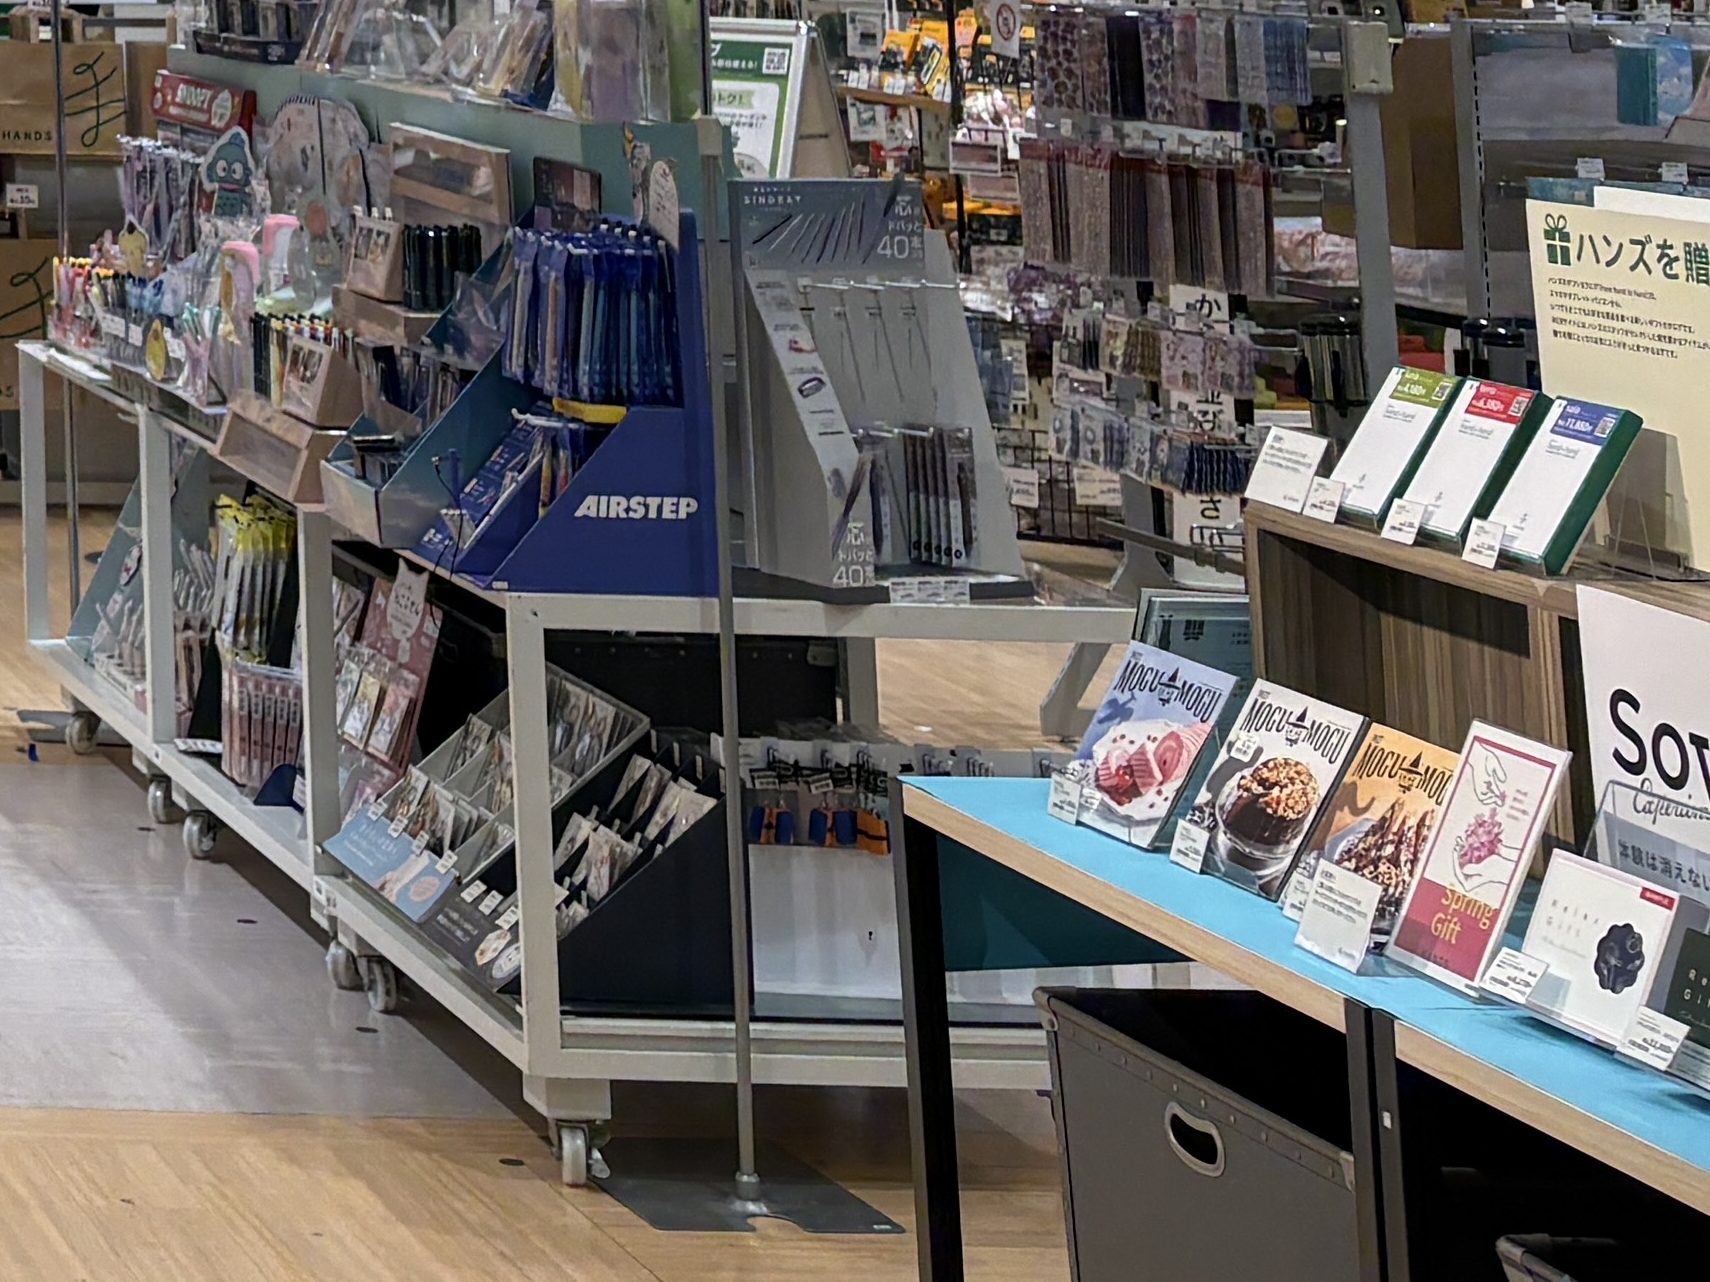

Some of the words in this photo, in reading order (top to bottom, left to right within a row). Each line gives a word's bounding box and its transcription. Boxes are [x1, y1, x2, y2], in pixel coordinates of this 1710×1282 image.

[2, 129, 53, 142] HANDS
[573, 493, 699, 520] AIRSTEP
[1112, 659, 1160, 695] MOGU
[1178, 679, 1224, 723] MOGU
[1239, 696, 1288, 734] MOGU
[1303, 720, 1352, 765] MOGU
[1351, 742, 1403, 779] MOGU
[1439, 883, 1498, 932] Spring
[1431, 908, 1464, 946] Gift
